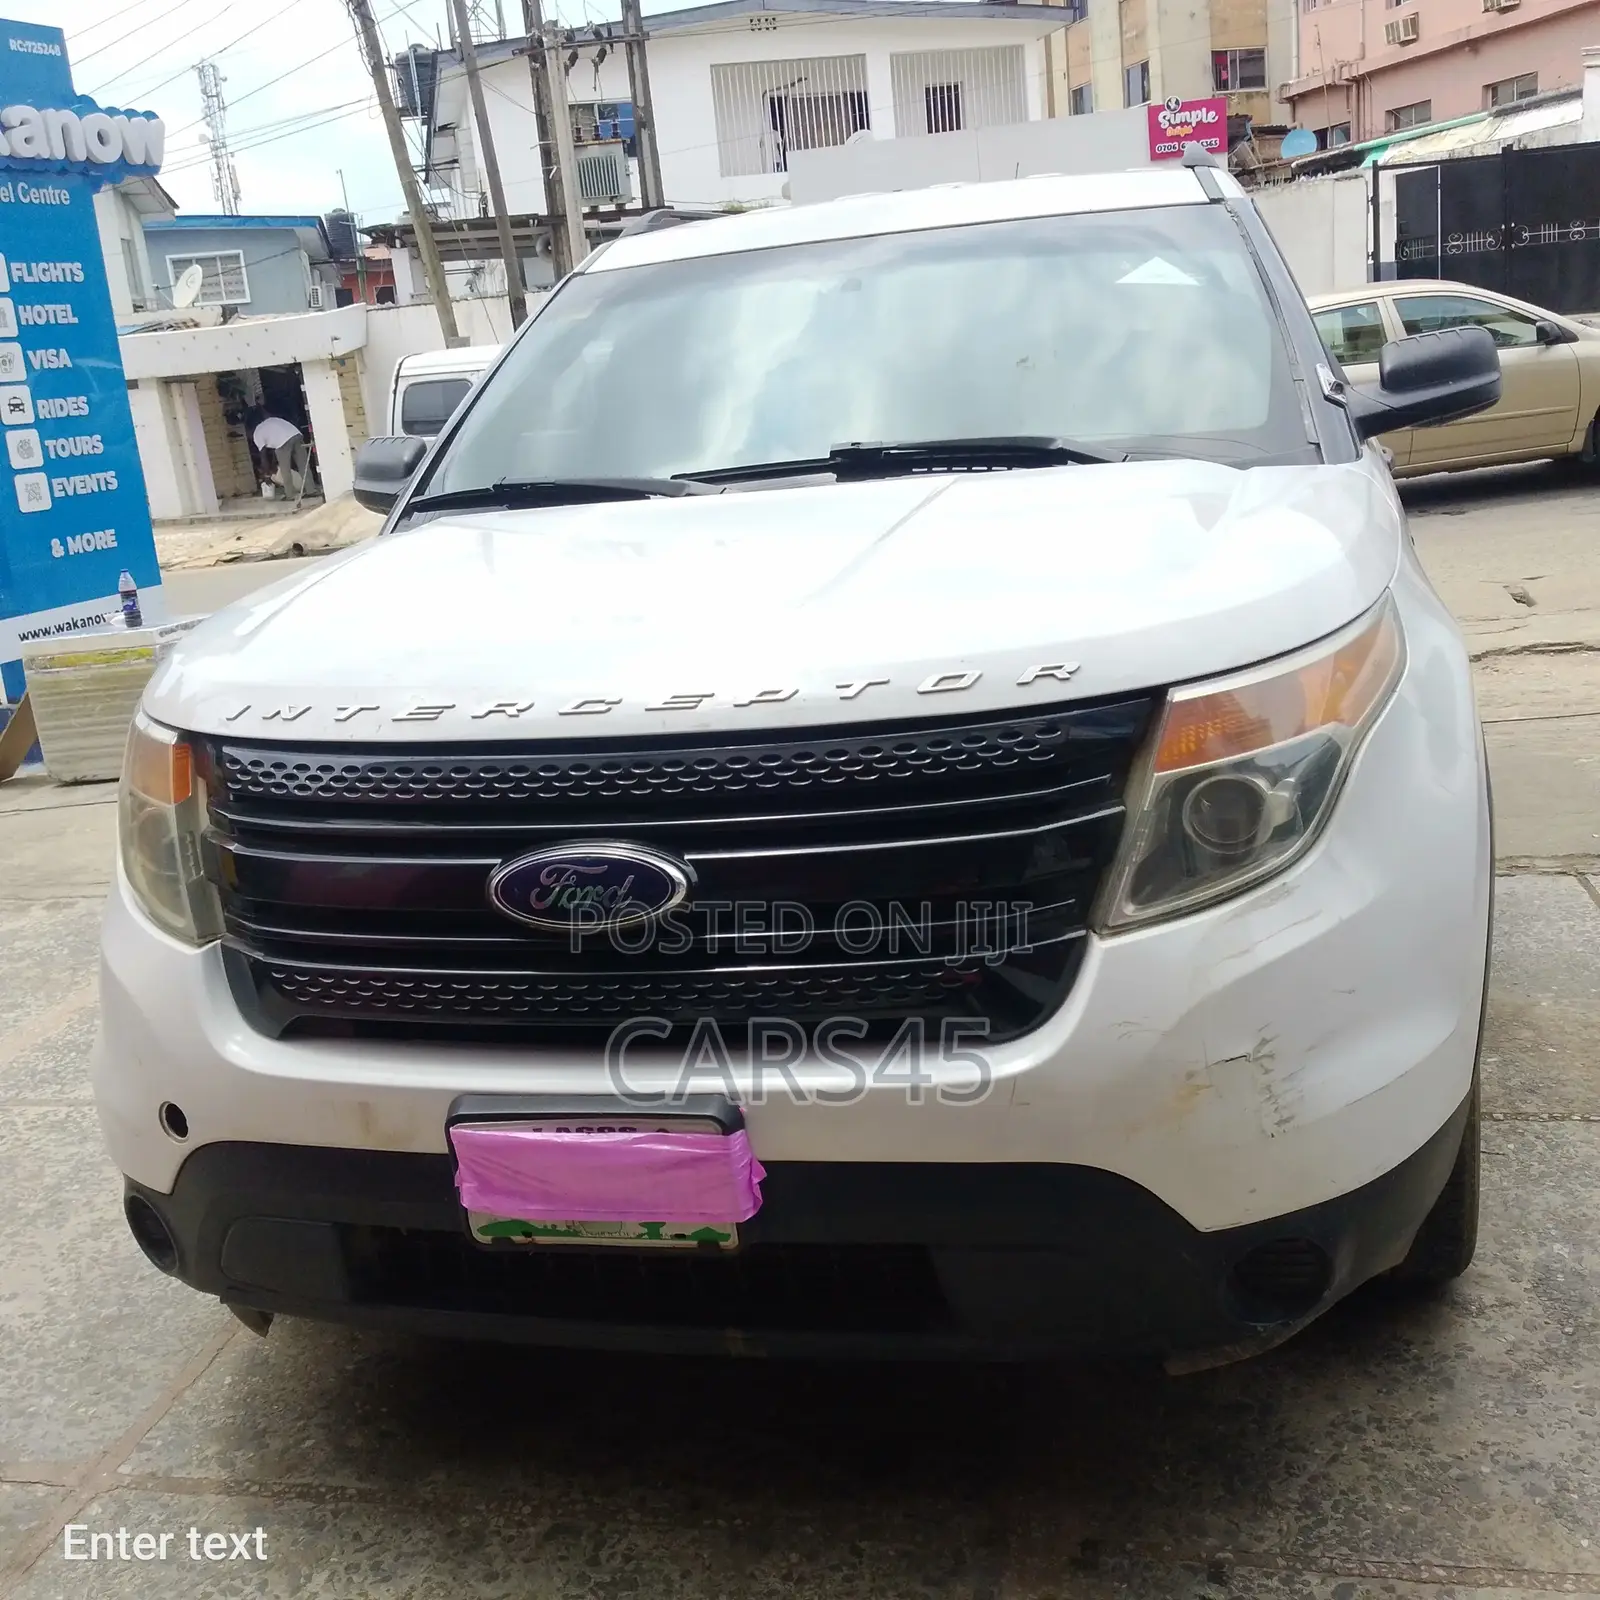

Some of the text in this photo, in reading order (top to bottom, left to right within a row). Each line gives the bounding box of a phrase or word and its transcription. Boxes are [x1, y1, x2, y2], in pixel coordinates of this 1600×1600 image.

[1158, 107, 1218, 129] Simple
[1156, 142, 1178, 153] 0706
[17, 182, 70, 205] Centre
[10, 262, 84, 283] FLIGHTS
[18, 304, 78, 326] HOTEL
[27, 348, 72, 370] VISA
[37, 396, 89, 419] RIDES
[45, 434, 104, 459] TOURS
[52, 471, 118, 498] EVENTS
[51, 528, 117, 558] & MORE
[225, 660, 1081, 721] INTERCEPTOR
[530, 864, 635, 909] Ford
